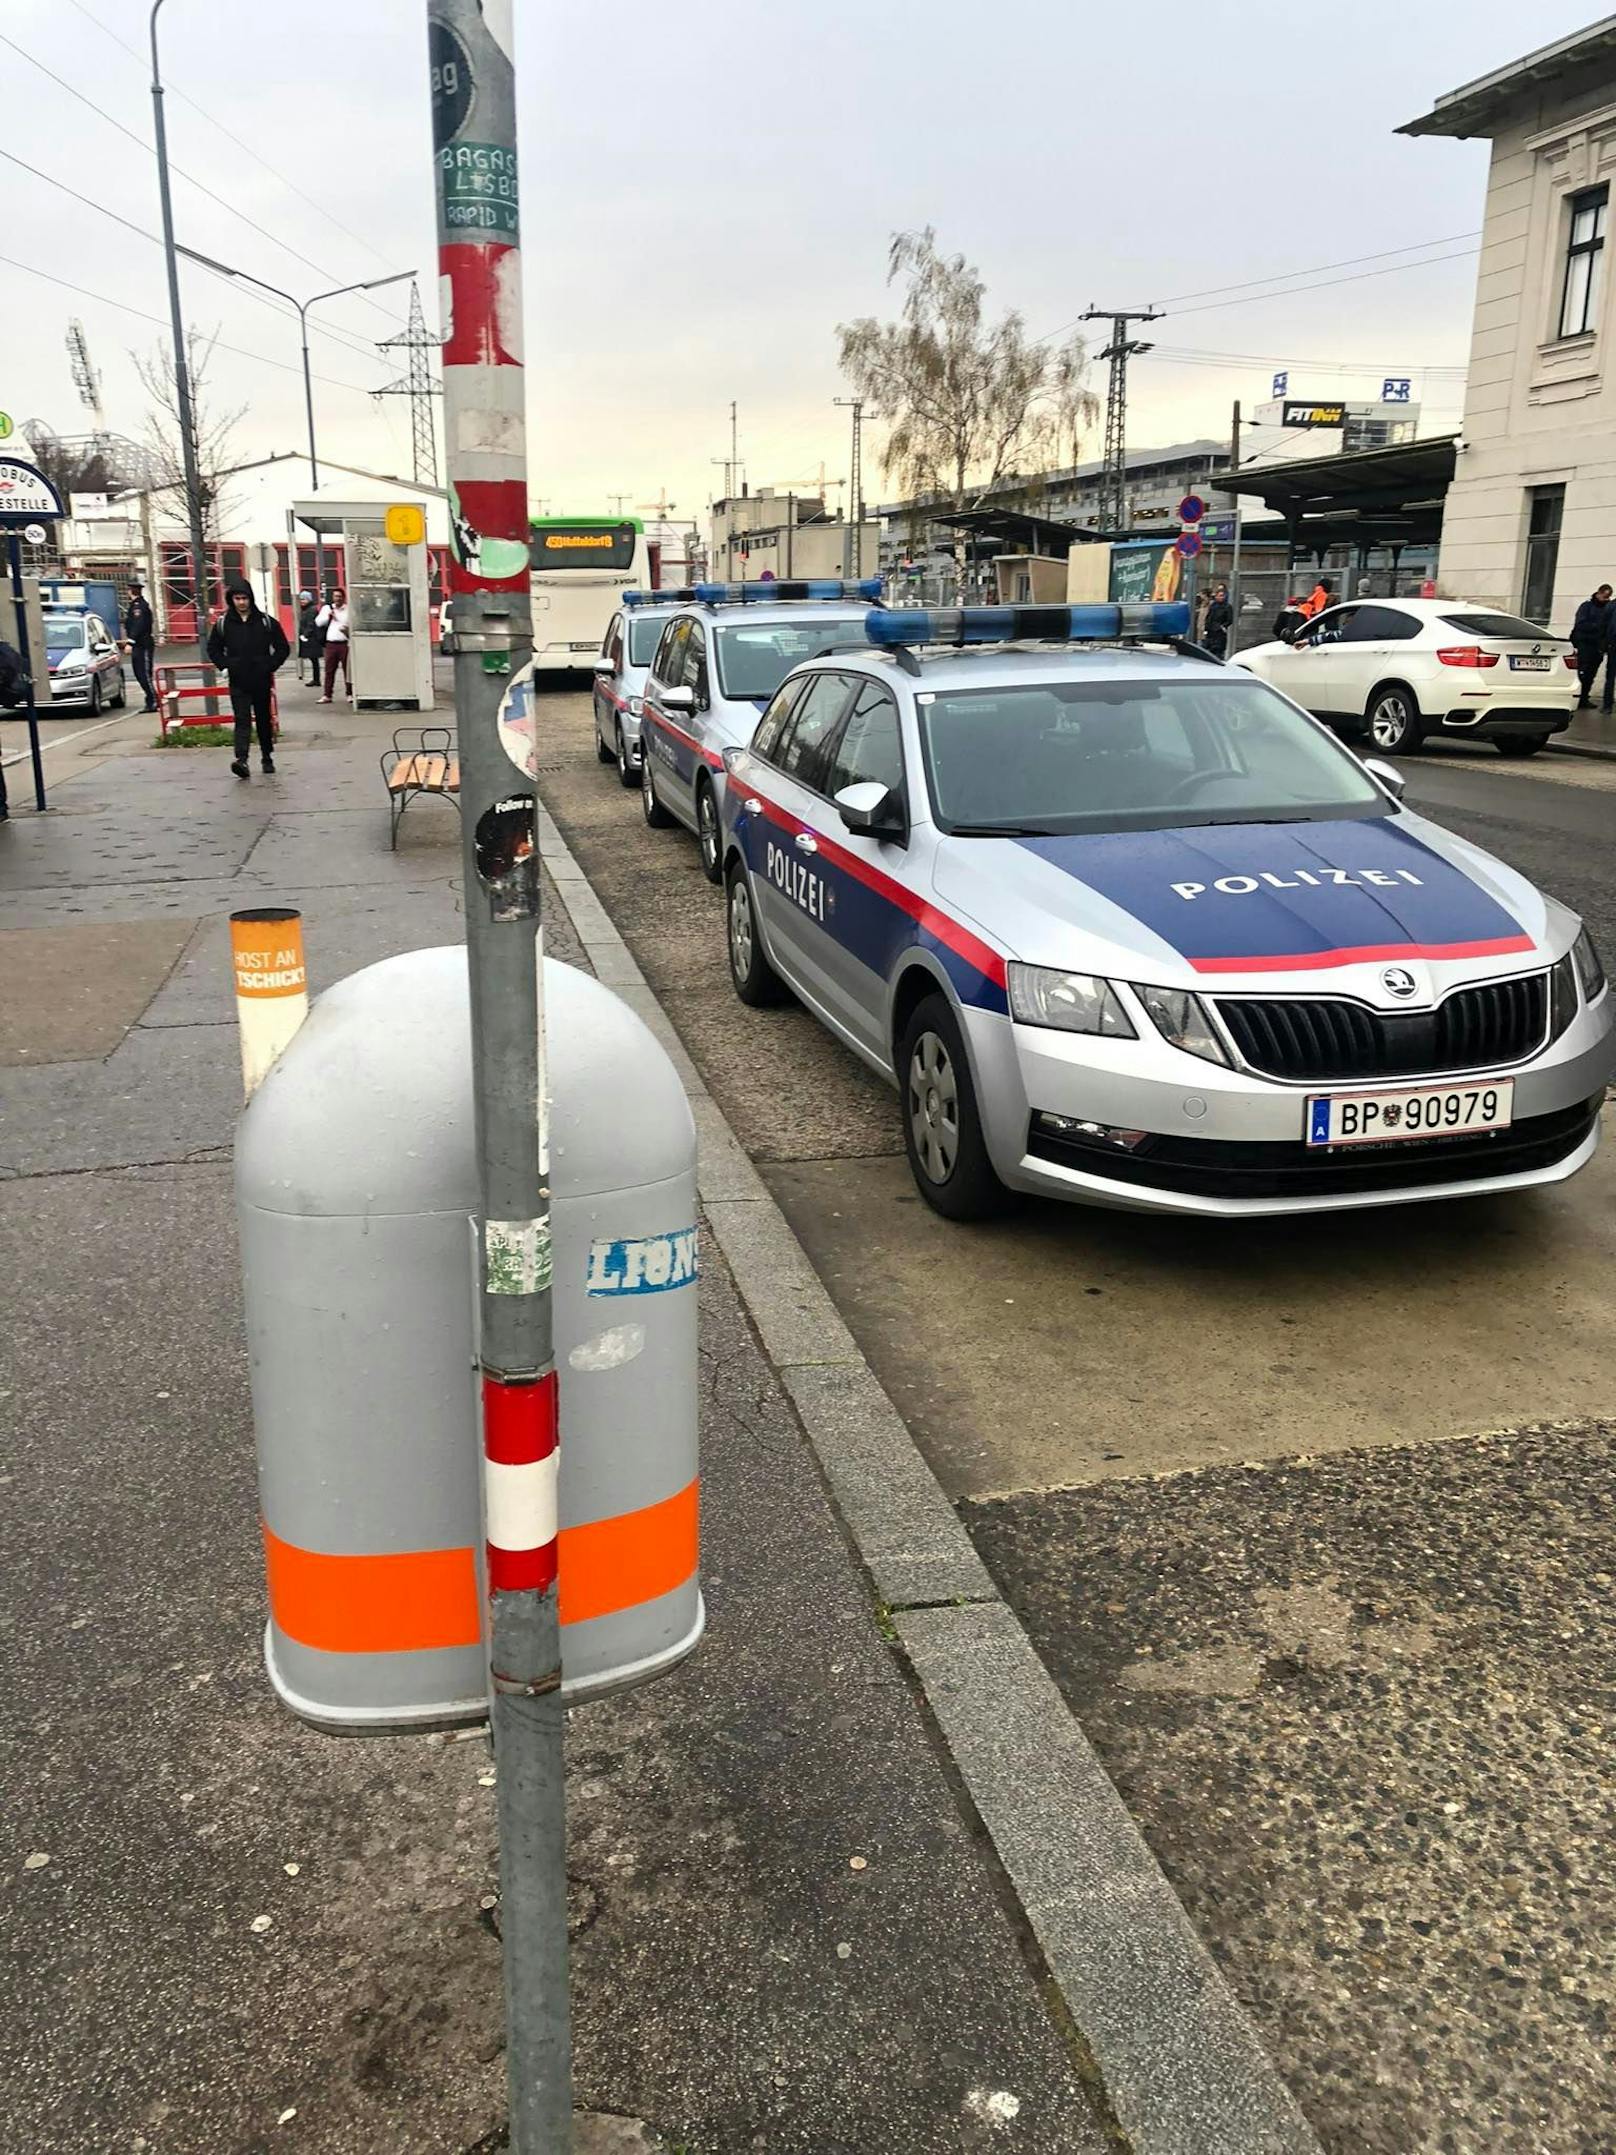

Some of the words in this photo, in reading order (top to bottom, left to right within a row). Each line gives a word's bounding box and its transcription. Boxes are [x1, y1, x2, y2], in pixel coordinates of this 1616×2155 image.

[447, 206, 497, 227] RAPID
[767, 842, 824, 921] POLIZEI
[1169, 868, 1425, 901] POLIZEI
[276, 949, 297, 967] AN
[1341, 1102, 1379, 1135] BP
[1405, 1090, 1498, 1130] 90979
[1315, 1126, 1326, 1136] A
